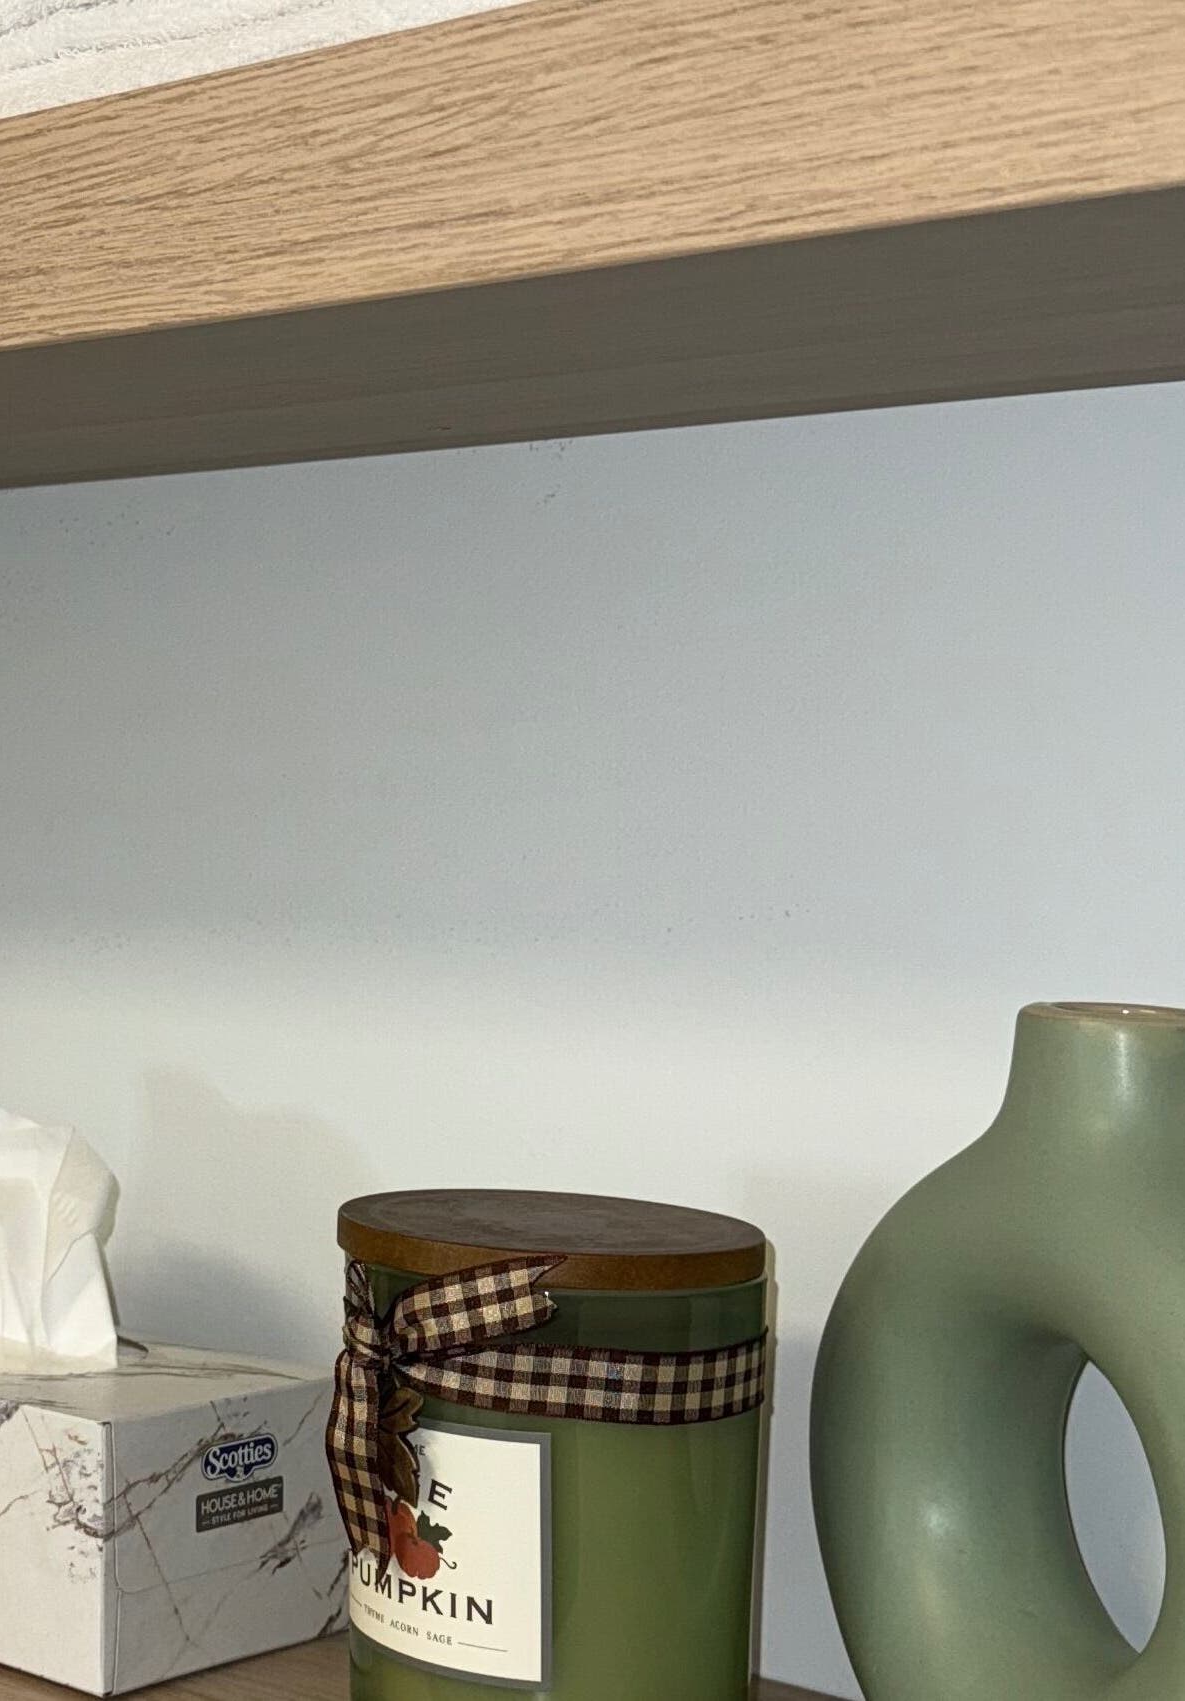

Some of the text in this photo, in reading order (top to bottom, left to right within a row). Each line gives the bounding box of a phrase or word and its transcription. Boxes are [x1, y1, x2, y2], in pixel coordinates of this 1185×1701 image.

[207, 1442, 272, 1476] Scotties
[211, 1513, 231, 1525] STYLE
[233, 1509, 246, 1520] FOR
[389, 1619, 419, 1636] ACORN
[426, 1630, 453, 1645] SAGE
